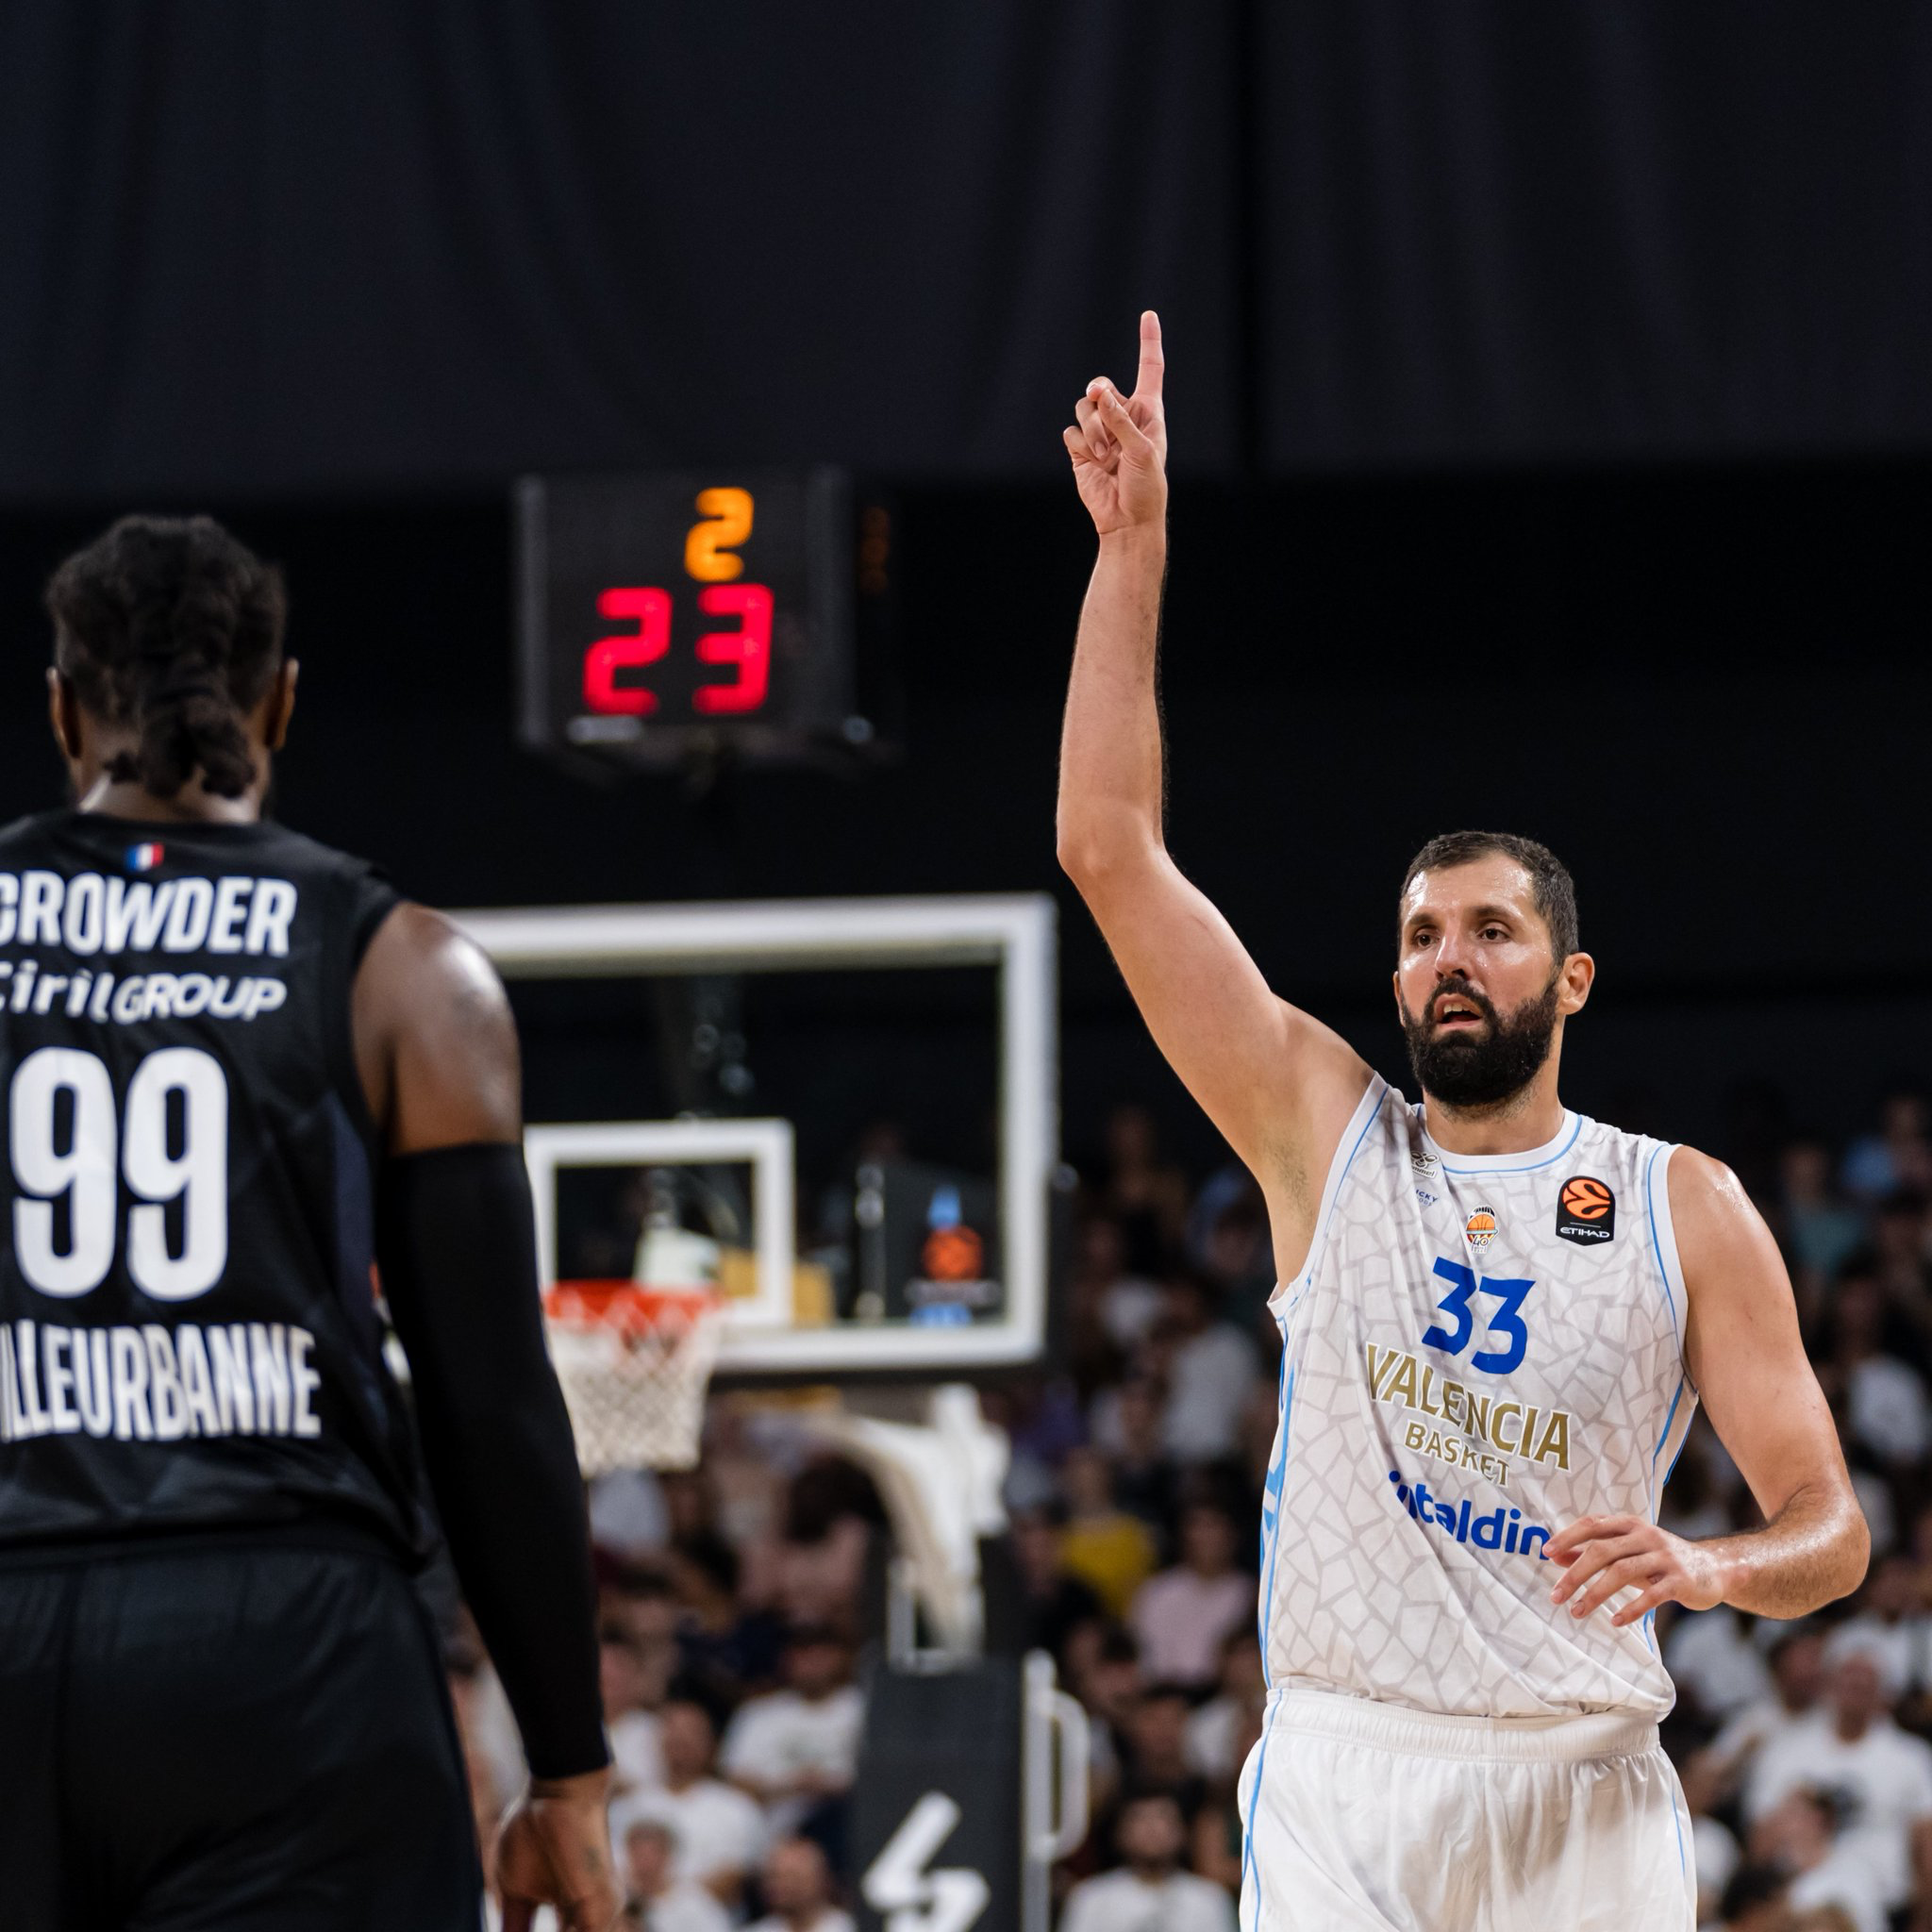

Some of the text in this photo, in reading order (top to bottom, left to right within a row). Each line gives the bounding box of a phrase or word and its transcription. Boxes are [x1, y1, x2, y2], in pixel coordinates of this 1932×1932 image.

[685, 487, 754, 583] 2
[582, 583, 774, 716] 23
[0, 959, 288, 1025] irilGROUP
[10, 1047, 228, 1301] 99
[1559, 1226, 1610, 1239] ETIHAD
[1422, 1257, 1537, 1374] 33
[1366, 1342, 1572, 1472] VALENCIA
[1405, 1420, 1510, 1488] BASKET
